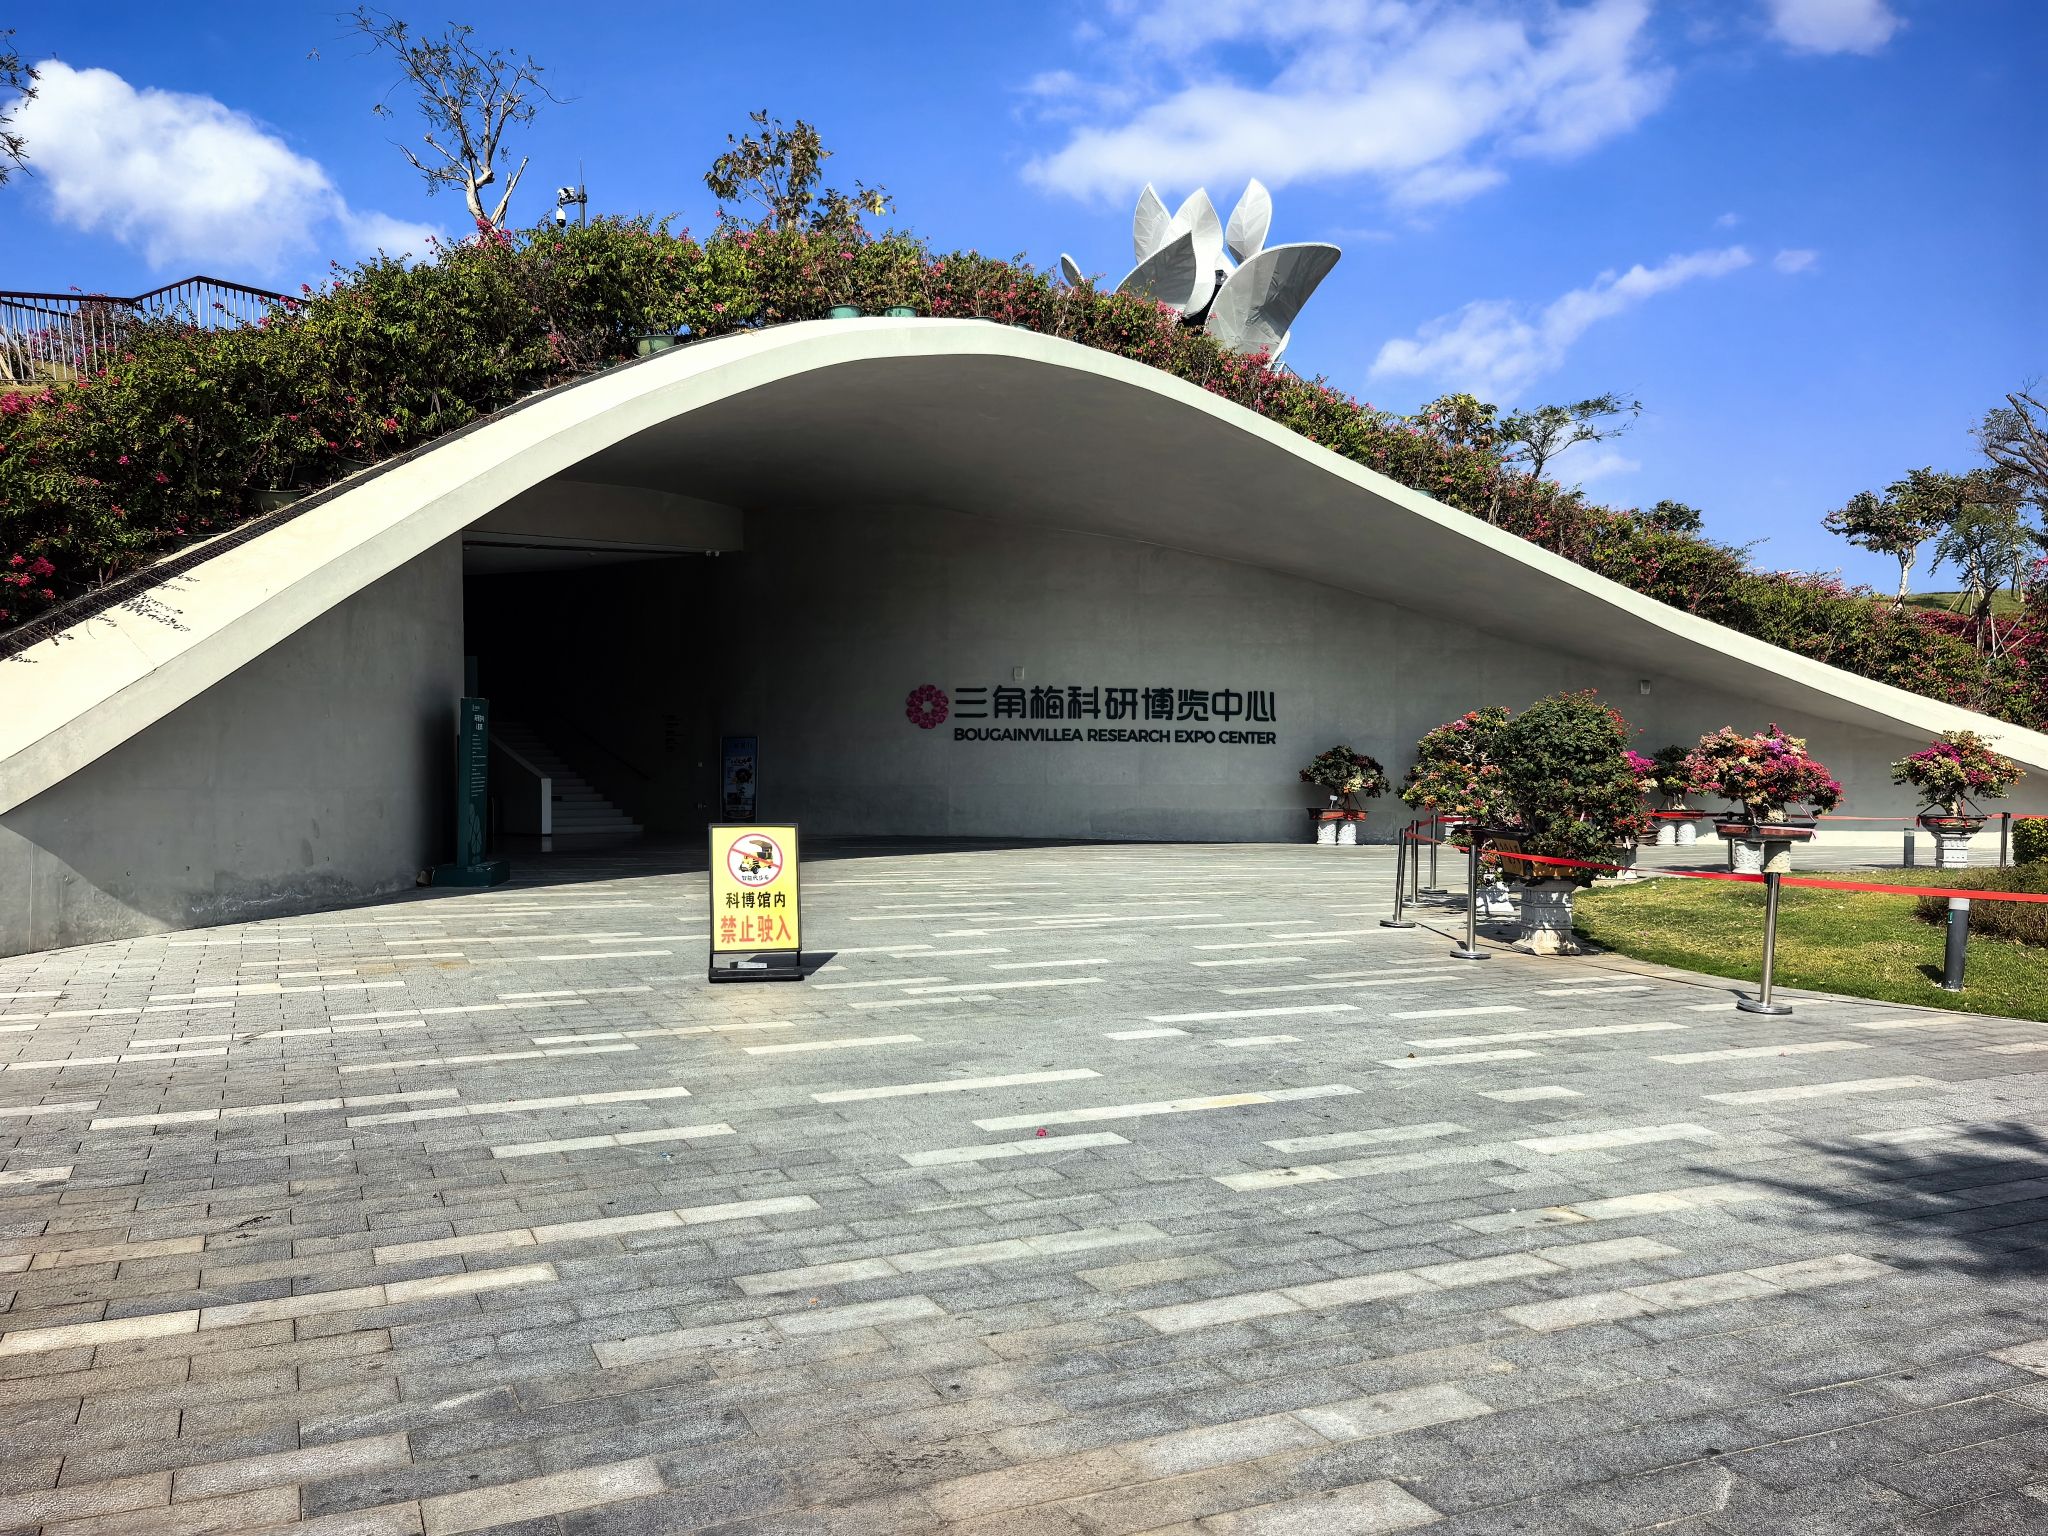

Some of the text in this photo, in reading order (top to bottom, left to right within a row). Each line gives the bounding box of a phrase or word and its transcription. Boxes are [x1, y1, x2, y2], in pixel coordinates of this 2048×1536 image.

[954, 685, 1276, 722] 三角梅科研博览中心
[954, 727, 1276, 745] BOUGAINVILLEA RESEARCH EXPO CENTER
[725, 891, 786, 909] 科博馆内
[720, 914, 792, 944] 禁止驶入
